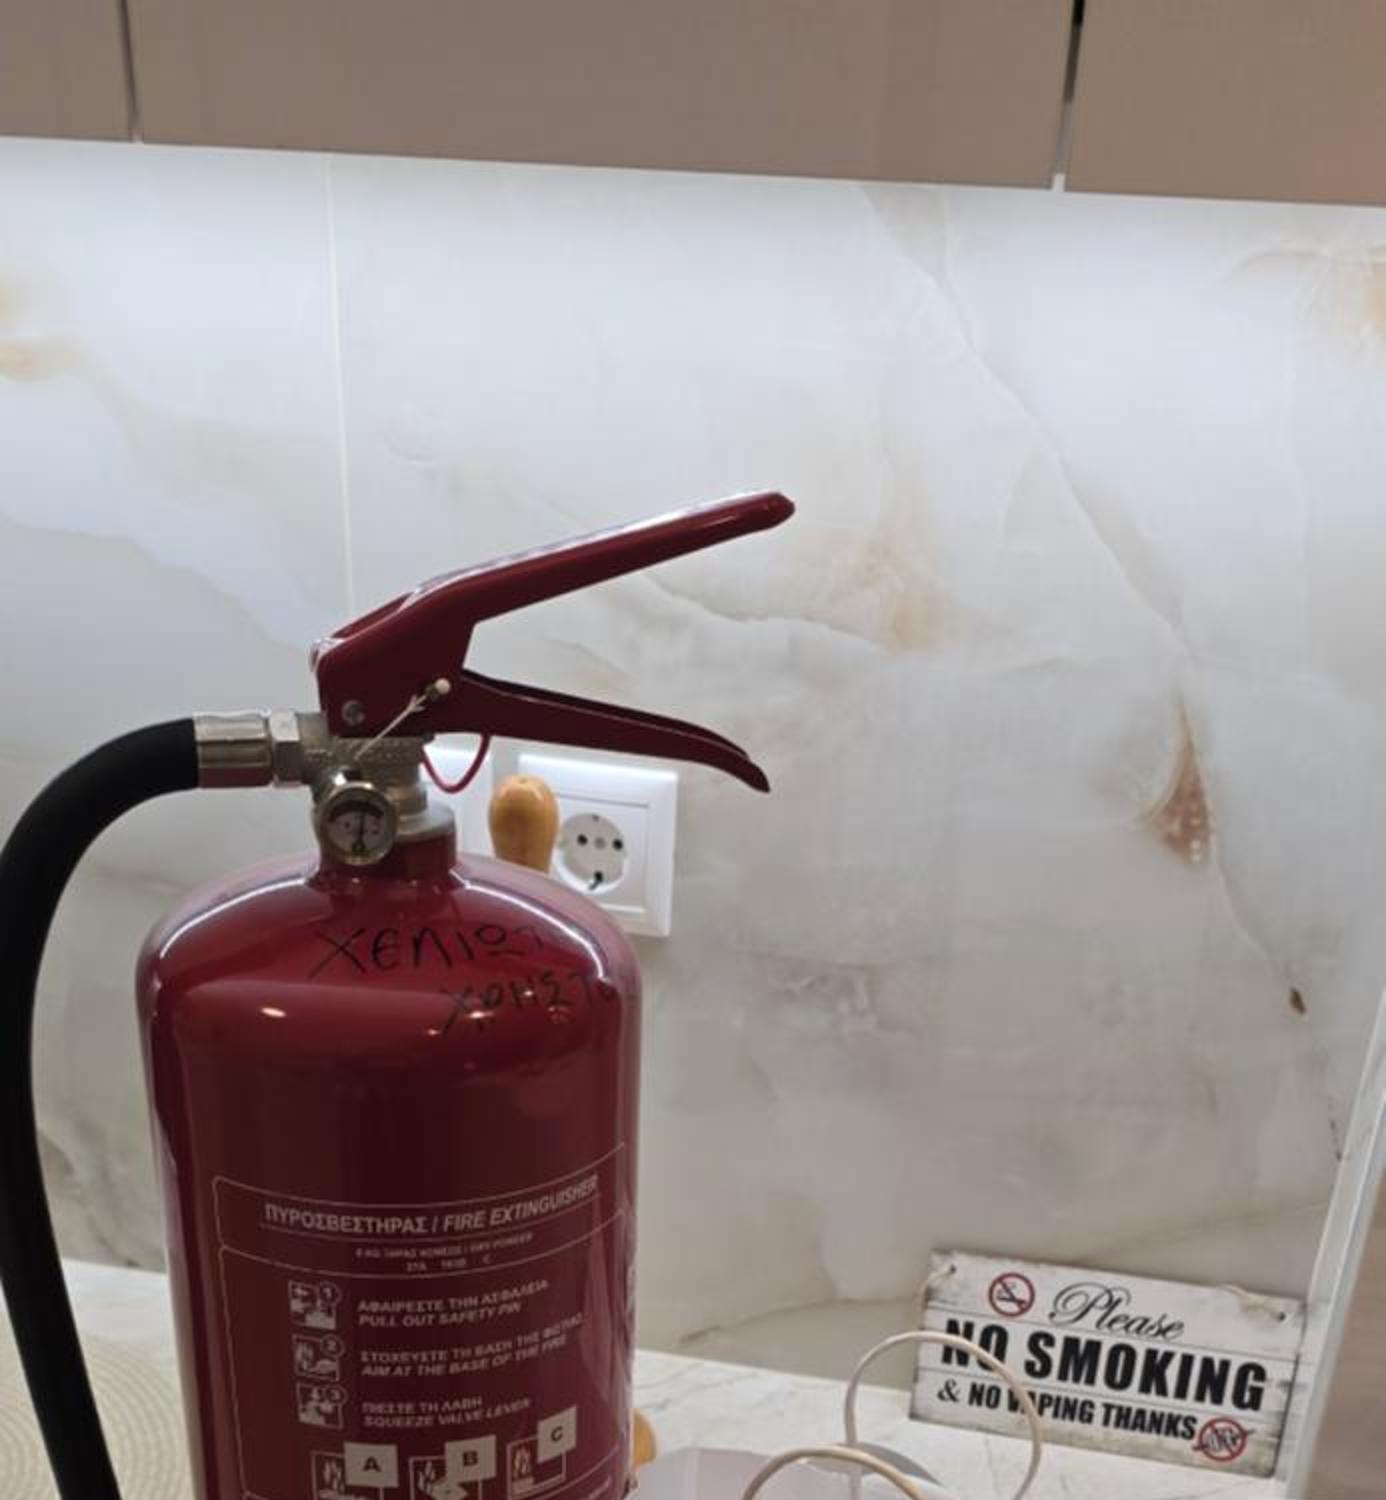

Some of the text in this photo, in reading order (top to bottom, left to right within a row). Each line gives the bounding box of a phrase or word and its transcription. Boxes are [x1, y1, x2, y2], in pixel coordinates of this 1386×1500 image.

[264, 1203, 428, 1233] ΠΥΡΟΣΒΕΣΤΗΡΑΣ
[443, 1210, 486, 1232] FIRE
[489, 1174, 600, 1226] EXTINGUISHER
[358, 1315, 396, 1327] PULL
[403, 1314, 435, 1327] OUT
[438, 1307, 495, 1325] SAFETY
[1048, 1281, 1186, 1341] Please
[393, 1364, 412, 1377] AT
[417, 1364, 447, 1377] THE
[449, 1358, 490, 1375] BASE
[492, 1353, 512, 1367] OF
[940, 1317, 1268, 1411] NO SMOKING
[937, 1379, 961, 1403] &
[968, 1382, 1000, 1410] NO
[1101, 1402, 1198, 1441] THANKS
[550, 1426, 563, 1442] C
[362, 1456, 382, 1473] A
[461, 1450, 479, 1467] B
